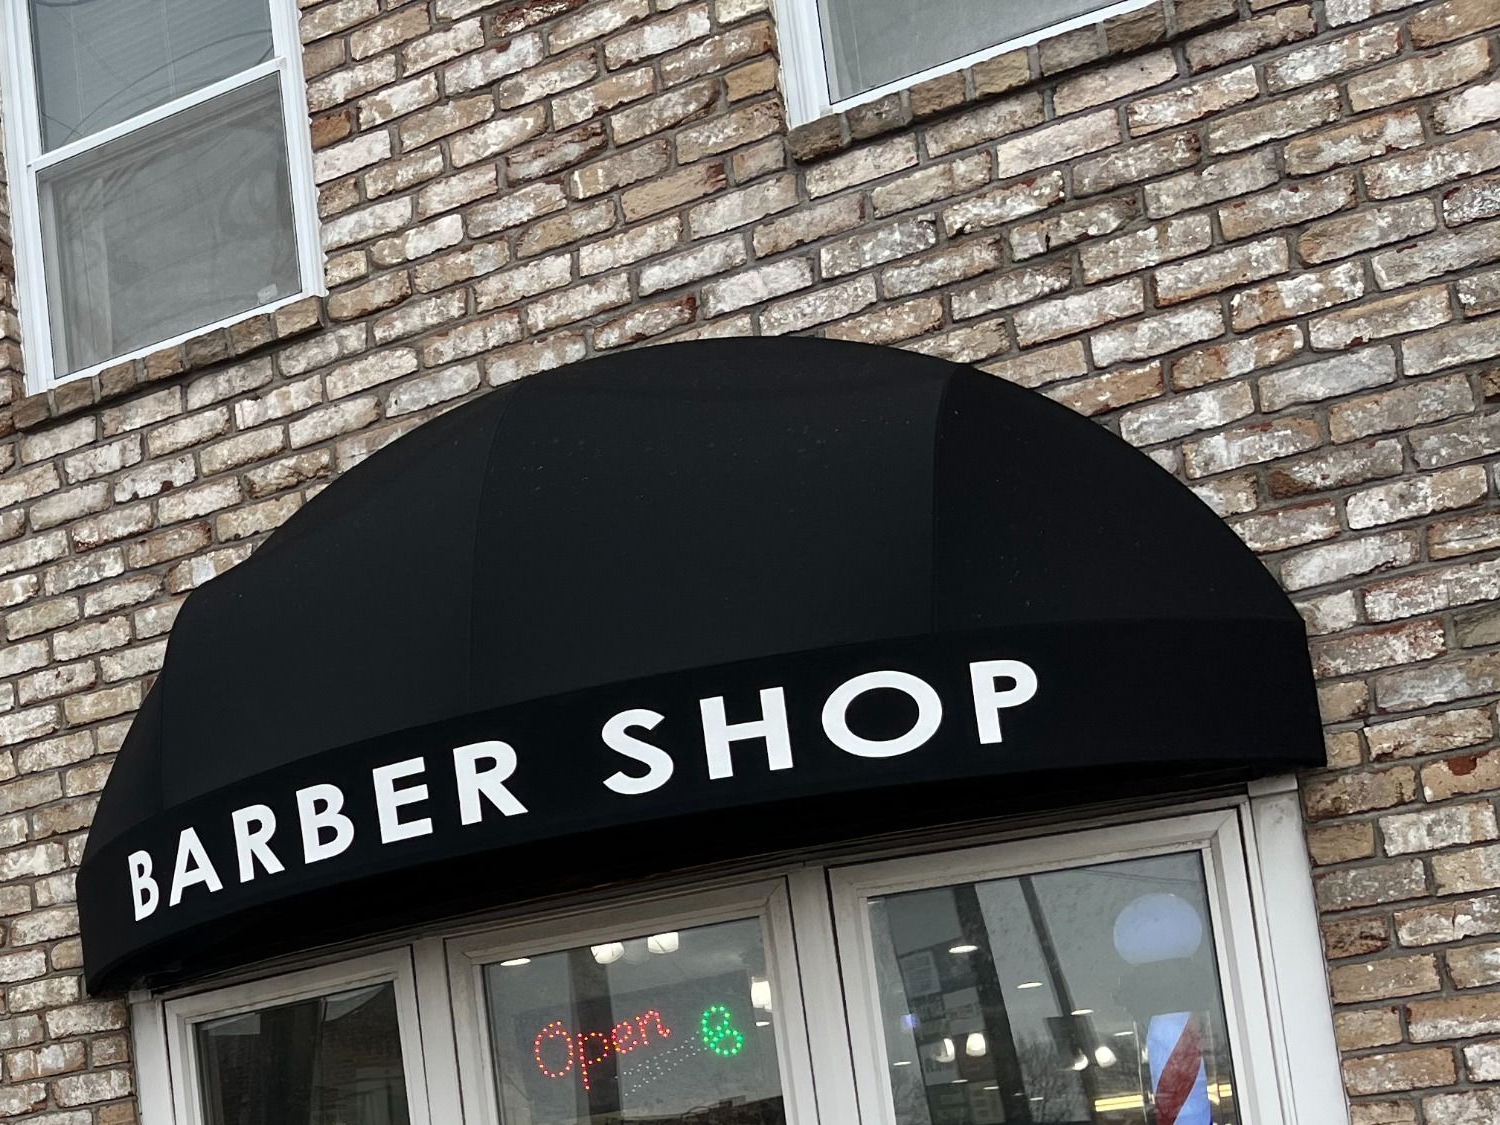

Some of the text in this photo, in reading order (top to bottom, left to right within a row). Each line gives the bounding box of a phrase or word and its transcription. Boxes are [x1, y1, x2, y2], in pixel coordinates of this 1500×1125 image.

[128, 659, 1038, 922] BARBER SHOP
[534, 1009, 672, 1091] Open
